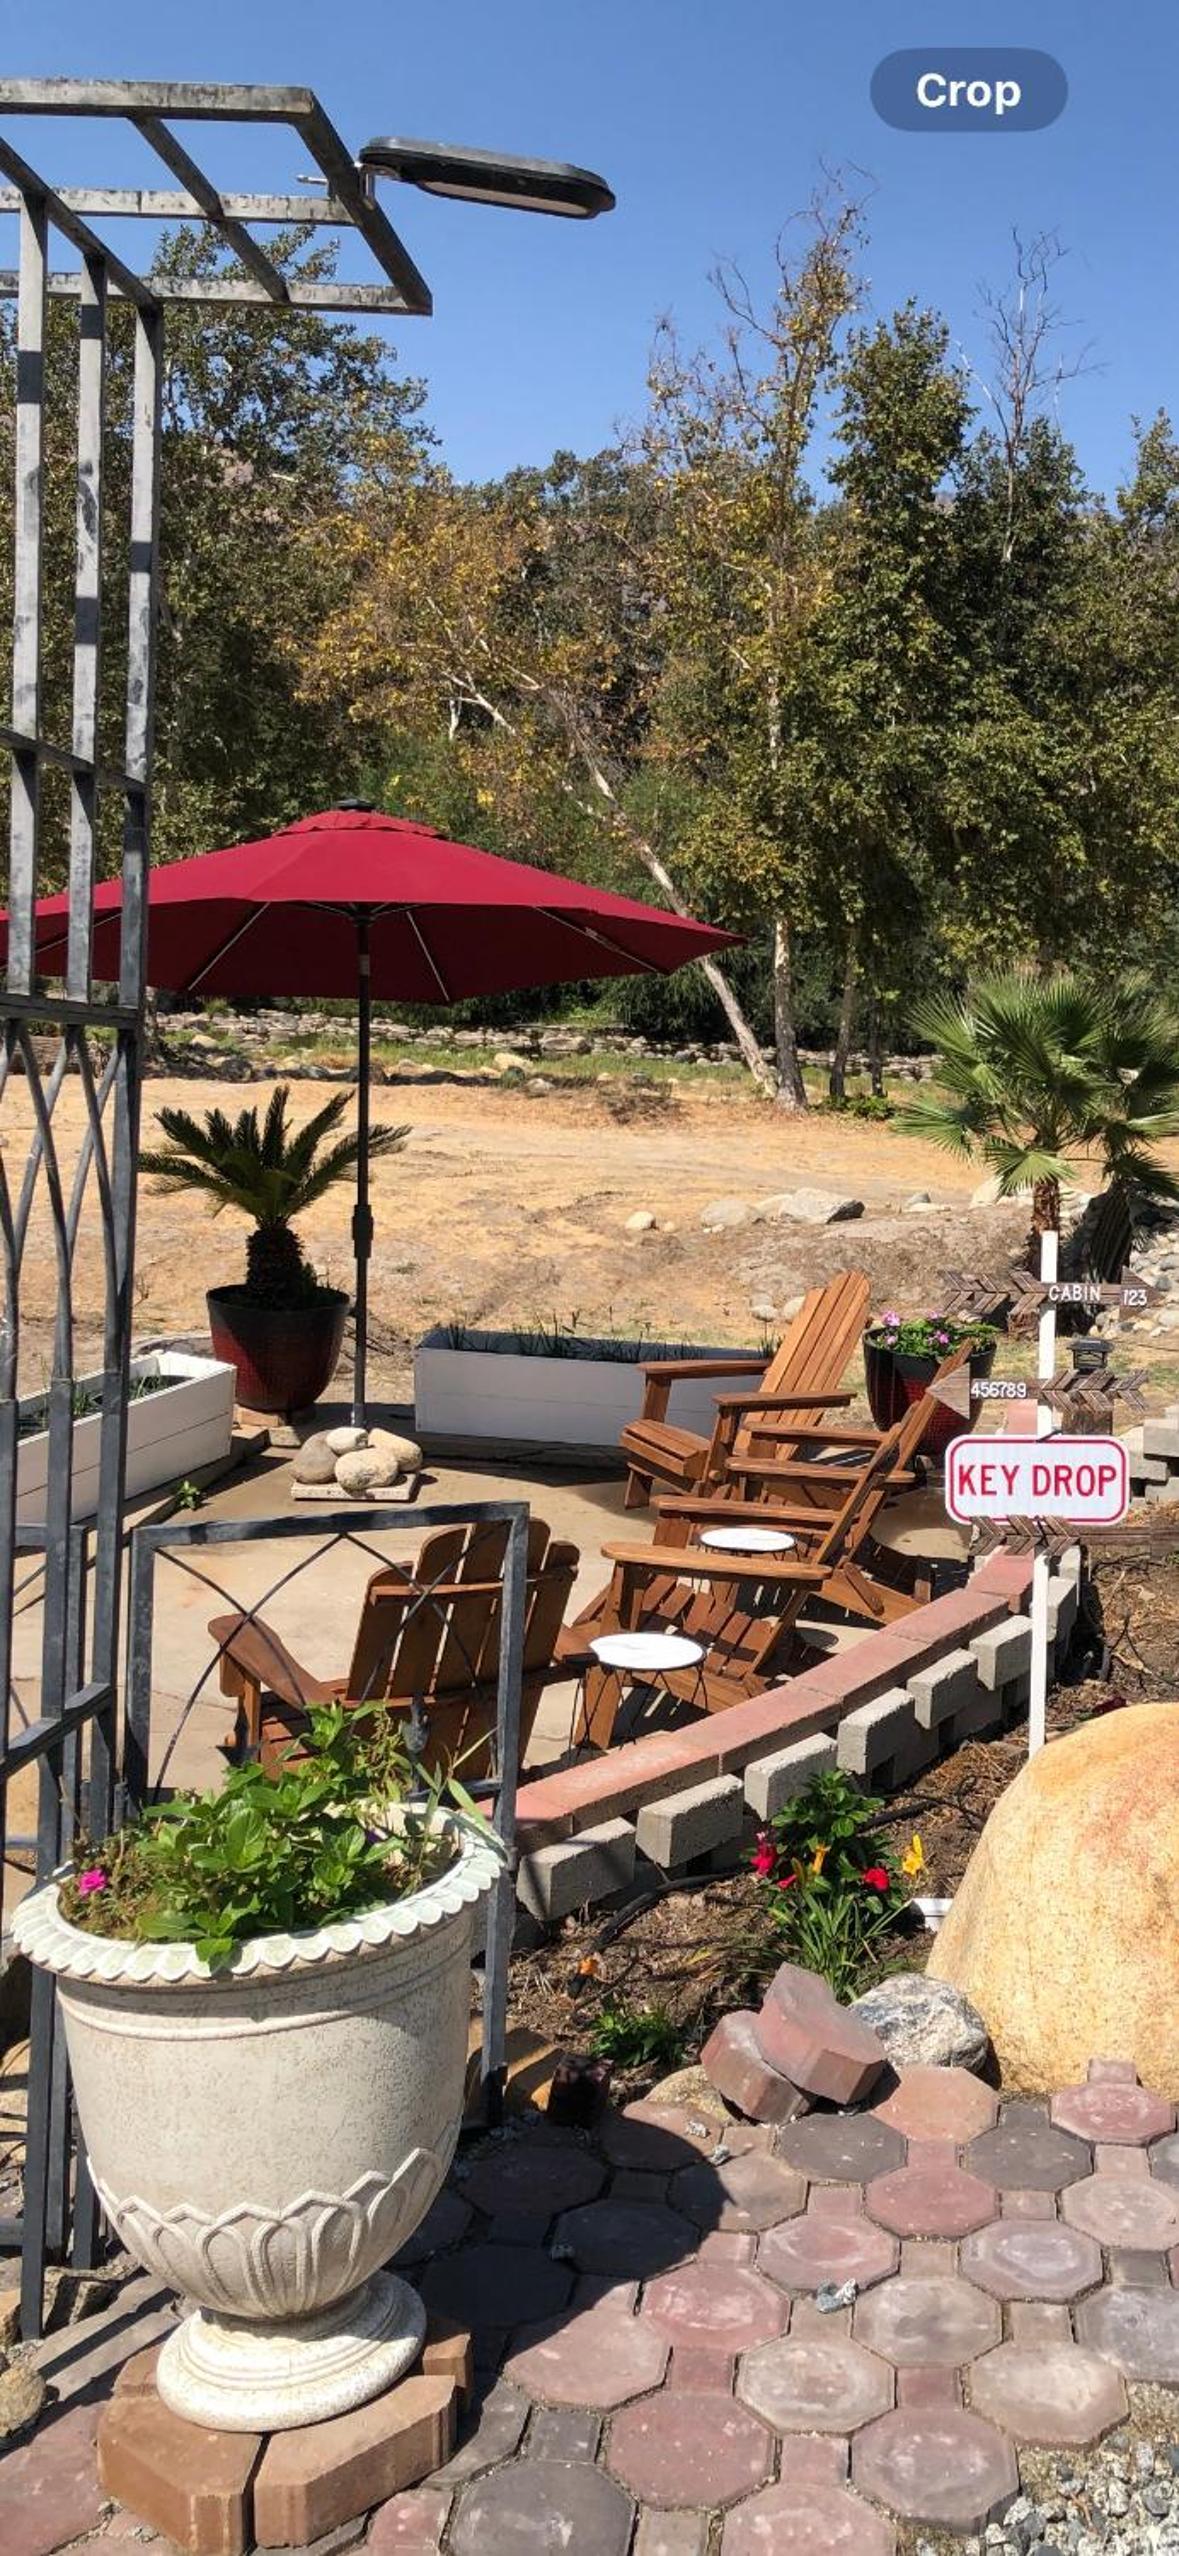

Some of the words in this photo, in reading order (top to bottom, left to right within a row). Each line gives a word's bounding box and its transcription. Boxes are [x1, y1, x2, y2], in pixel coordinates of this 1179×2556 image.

[1049, 1284, 1101, 1302] CABIN
[1122, 1289, 1148, 1306] 123
[970, 1381, 1027, 1398] 456789
[958, 1465, 1020, 1497] KEY
[1032, 1464, 1117, 1497] DROP
